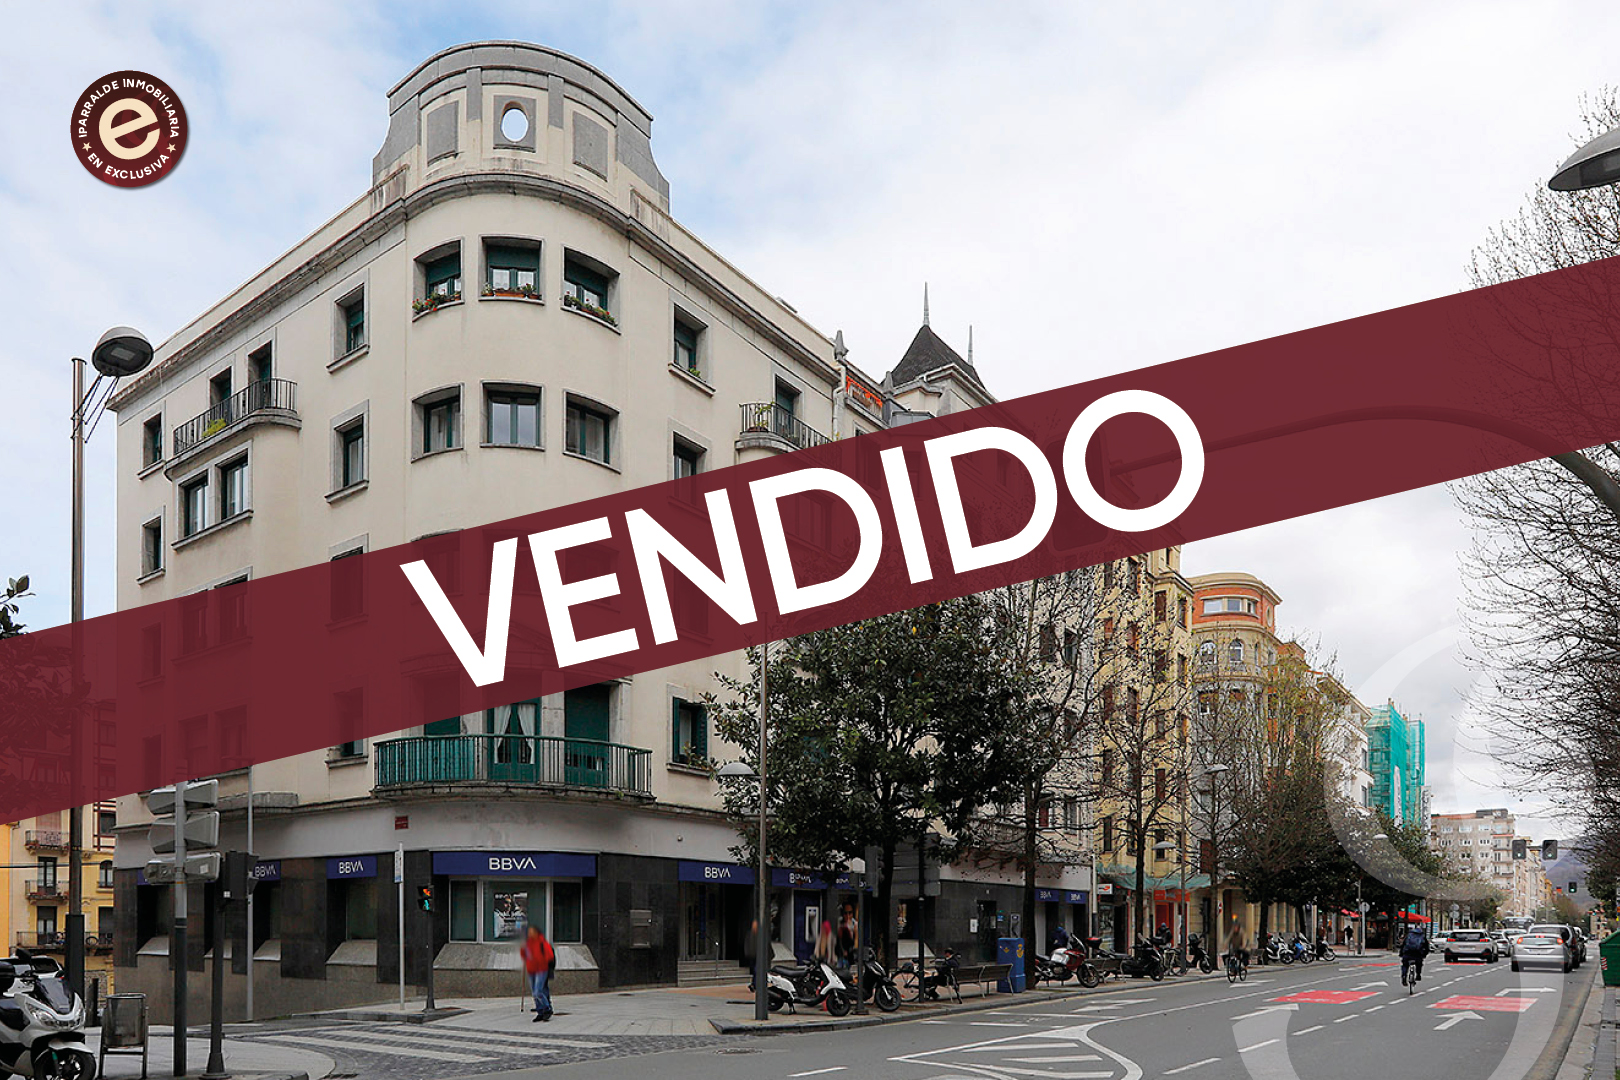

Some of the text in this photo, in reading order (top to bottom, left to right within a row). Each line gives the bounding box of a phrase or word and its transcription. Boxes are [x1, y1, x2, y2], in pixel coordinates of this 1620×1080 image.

[338, 860, 364, 874] BBVA
[488, 856, 537, 871] BBVA
[254, 864, 276, 878] BBVA
[704, 866, 731, 879] BBVA
